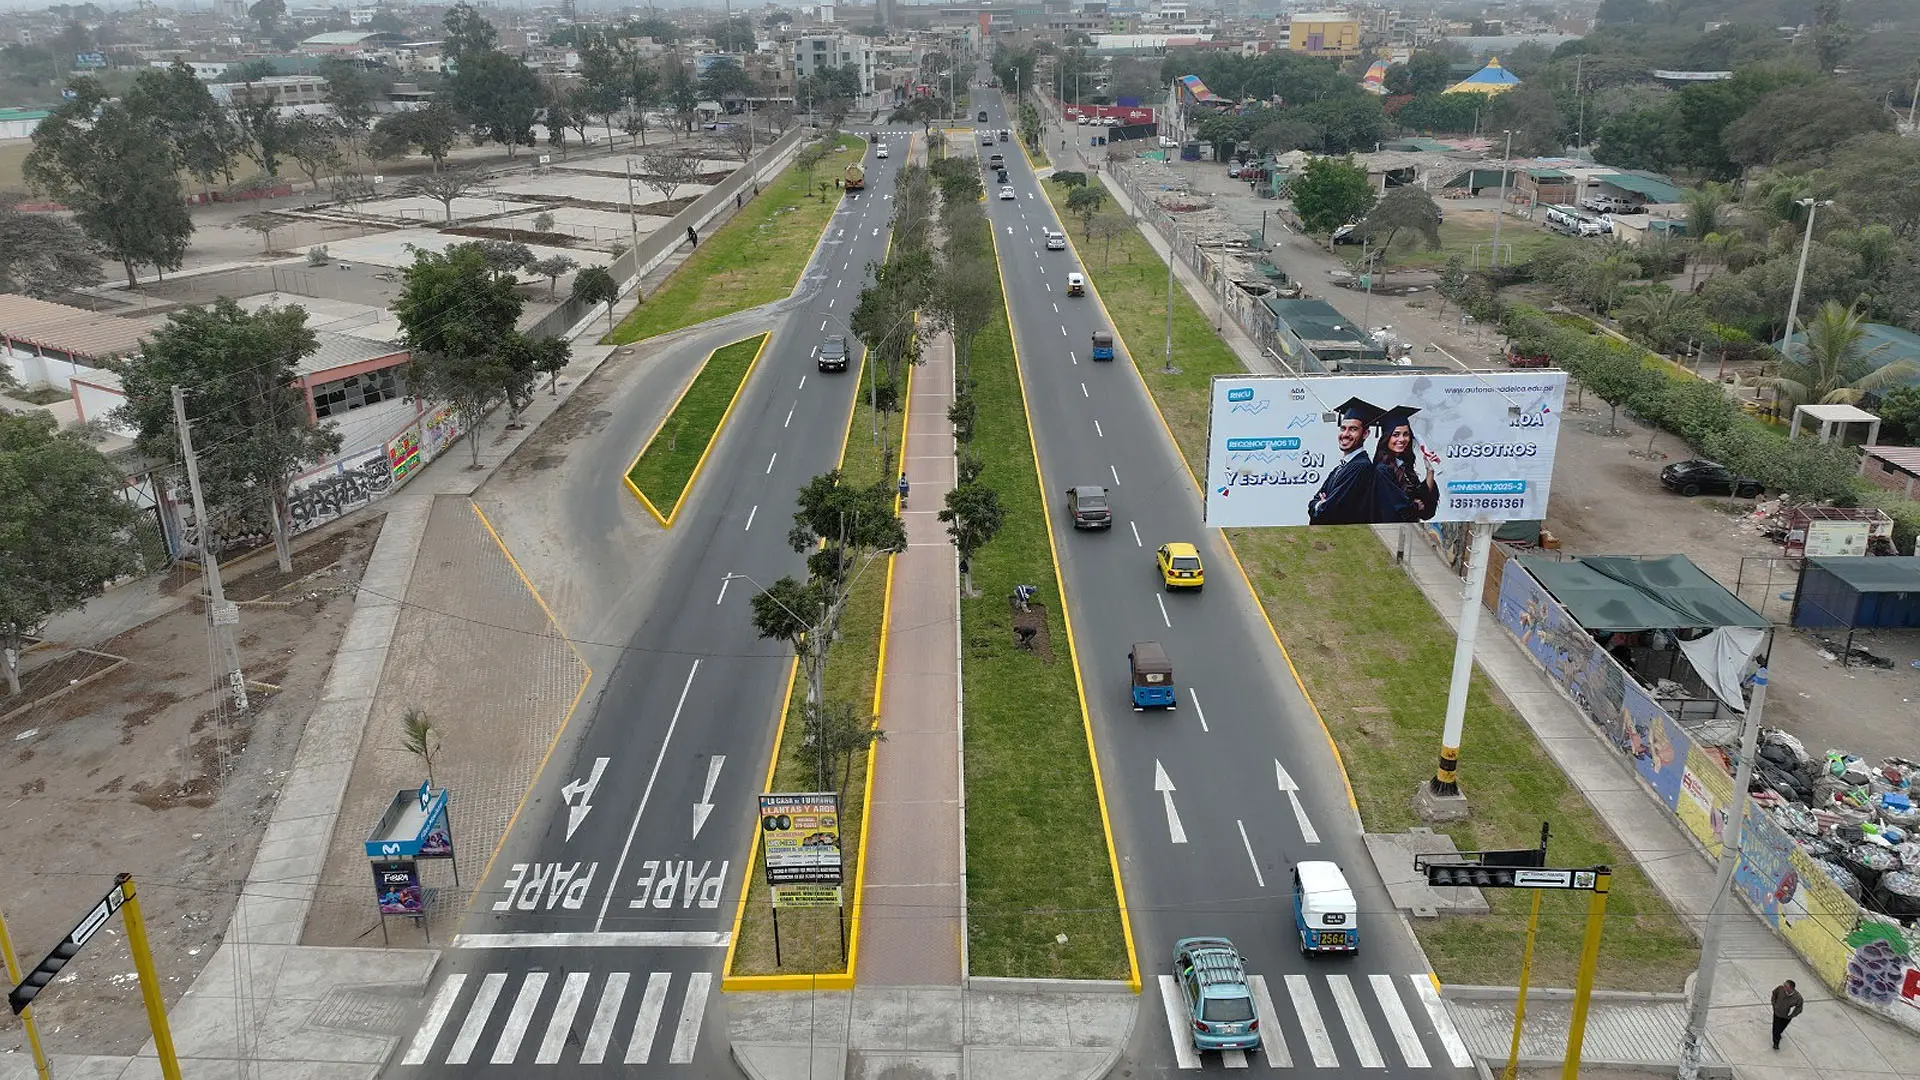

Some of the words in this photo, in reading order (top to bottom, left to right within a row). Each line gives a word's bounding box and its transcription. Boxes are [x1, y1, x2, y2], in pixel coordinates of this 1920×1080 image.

[1446, 442, 1537, 458] NOSOTROS
[1225, 471, 1238, 486] Y
[762, 806, 802, 814] LLANTAS
[491, 861, 599, 911] PARE
[628, 860, 729, 909] PARE
[1321, 933, 1344, 945] 2564
